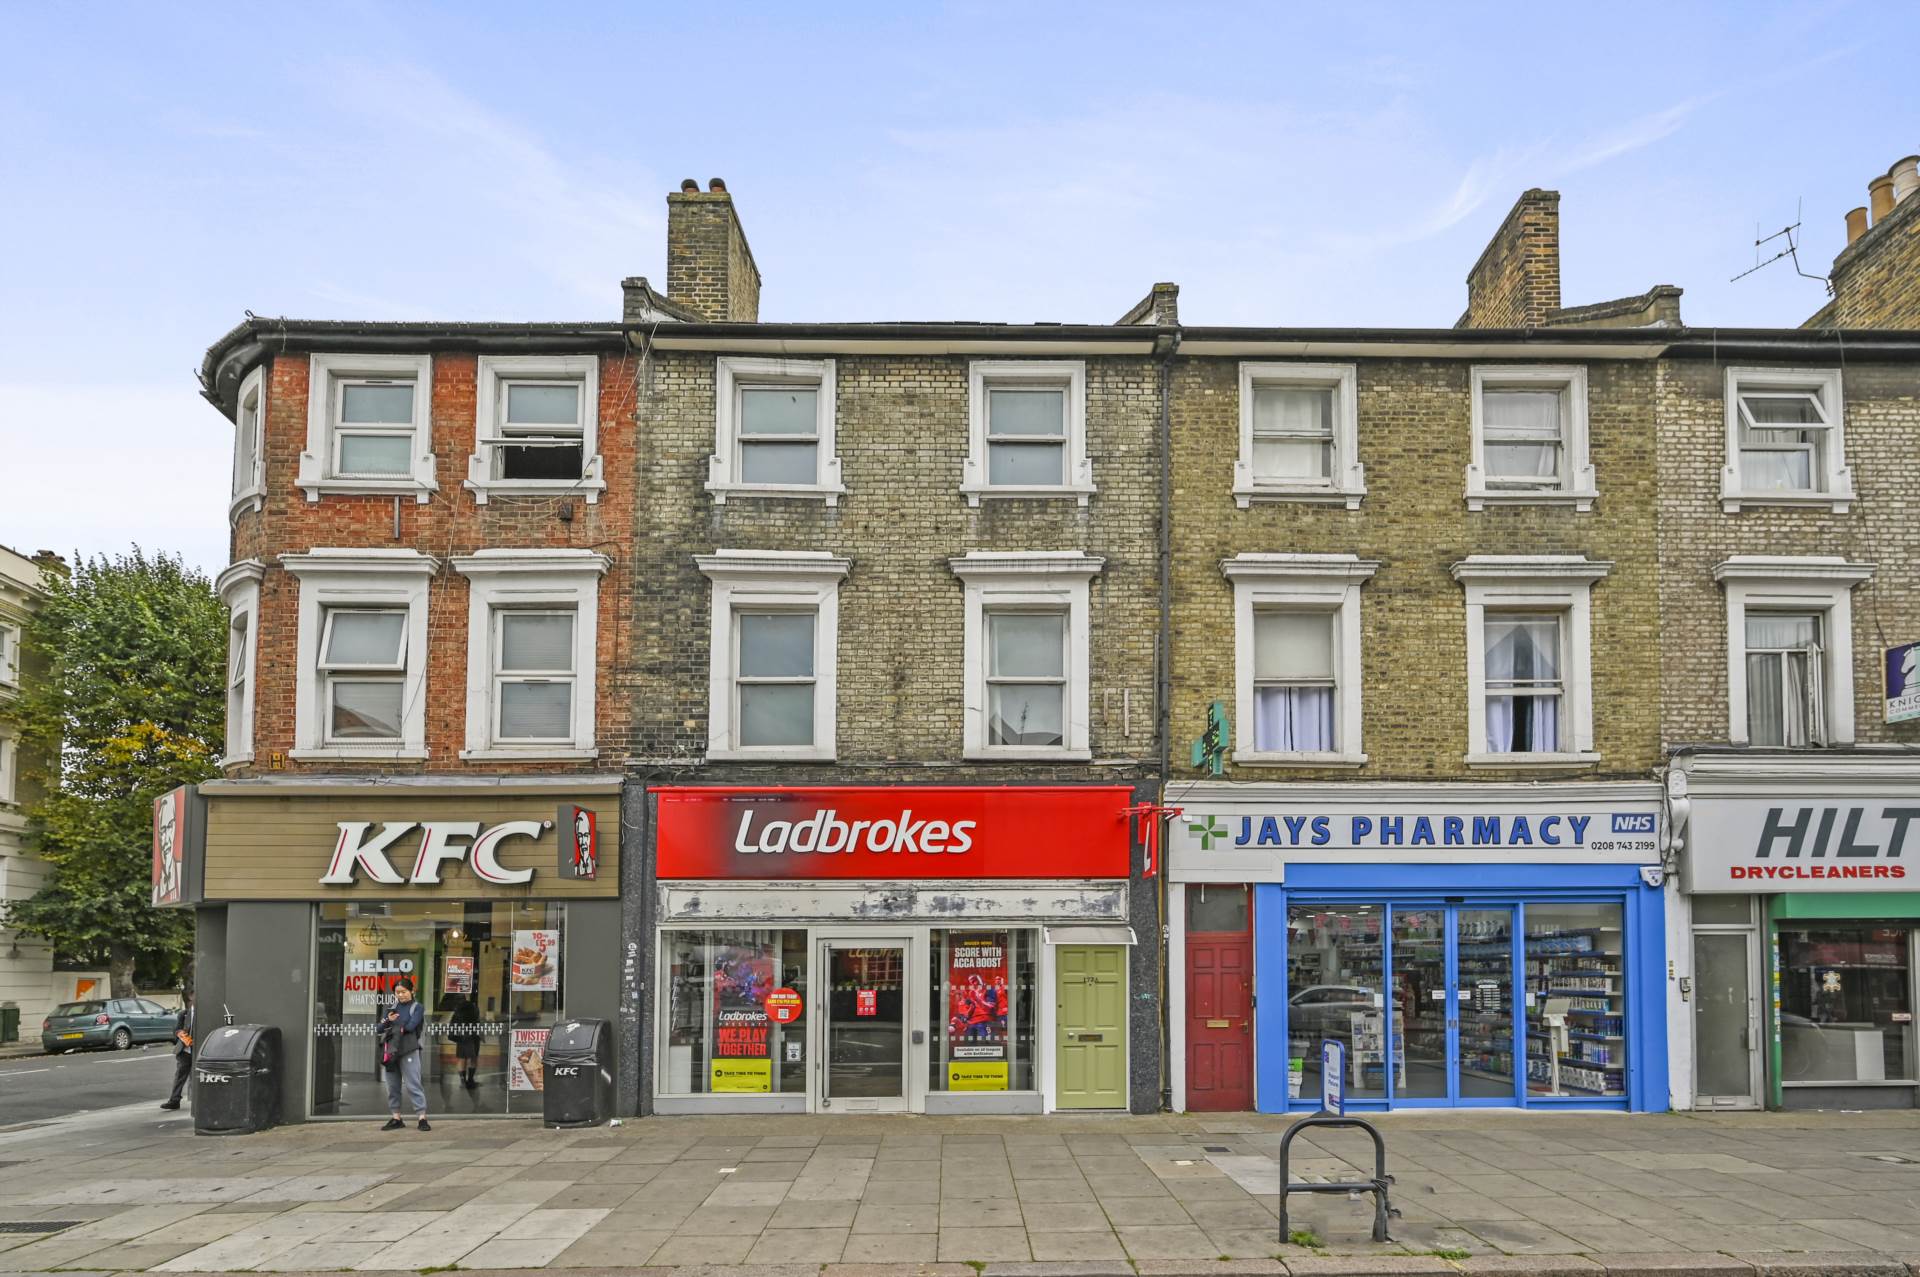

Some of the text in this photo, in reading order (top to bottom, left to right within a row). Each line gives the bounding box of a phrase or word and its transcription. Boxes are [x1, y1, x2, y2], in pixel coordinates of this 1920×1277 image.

[1235, 815, 1591, 846] JAYS PHARMACY
[1614, 816, 1652, 831] NHS
[734, 809, 977, 854] Ladbrokes
[1755, 807, 1920, 858] HILT
[318, 820, 543, 884] KFC
[1591, 841, 1655, 850] 0208 743 2199
[1730, 865, 1906, 879] DRYCLEANERS
[954, 946, 1002, 958] SCORE WITH
[349, 958, 414, 973] HELLO
[953, 957, 1001, 969] ACCA BOOST
[344, 975, 387, 992] ACTON
[718, 1010, 769, 1021] Ladbrokes
[739, 1028, 768, 1043] PLAY
[718, 1042, 768, 1056] TOGETHER
[554, 1066, 579, 1076] KFC
[205, 1074, 232, 1083] KFC
